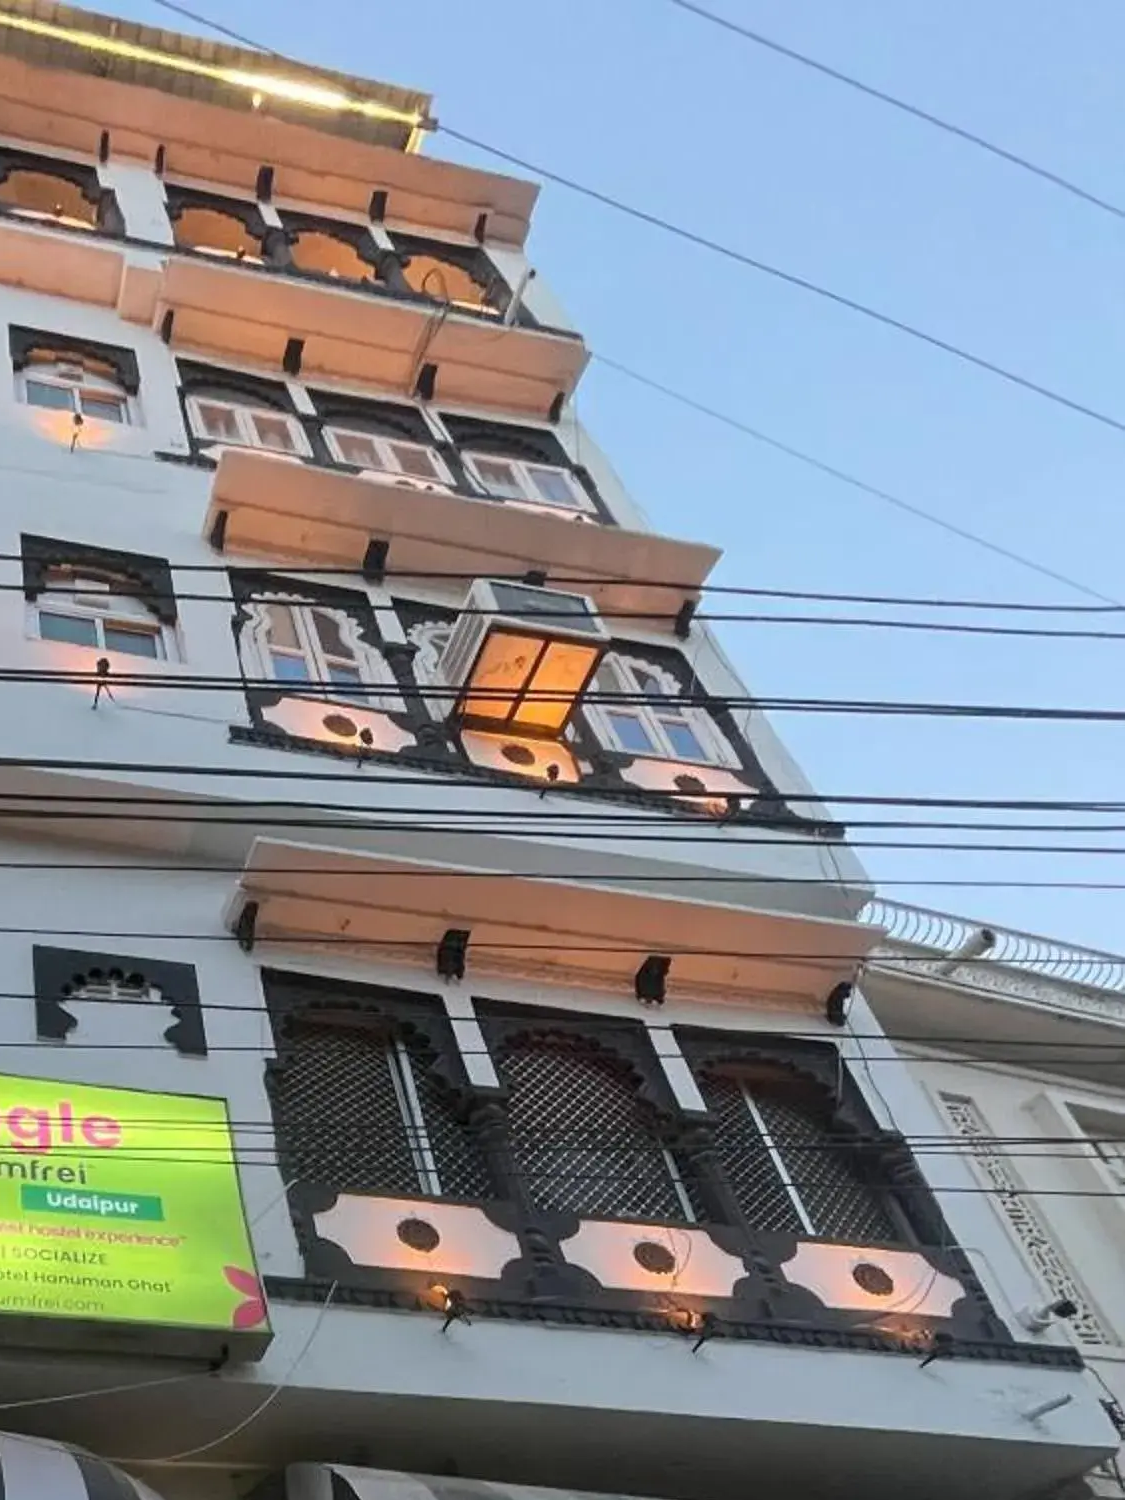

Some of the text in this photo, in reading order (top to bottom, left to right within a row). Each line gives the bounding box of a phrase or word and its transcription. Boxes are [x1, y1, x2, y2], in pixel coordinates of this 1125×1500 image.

[45, 1190, 139, 1215] Udaipur
[12, 1246, 109, 1266] SOCIALIZE
[33, 1270, 124, 1290] Hanuman
[127, 1278, 172, 1293] Ghat
